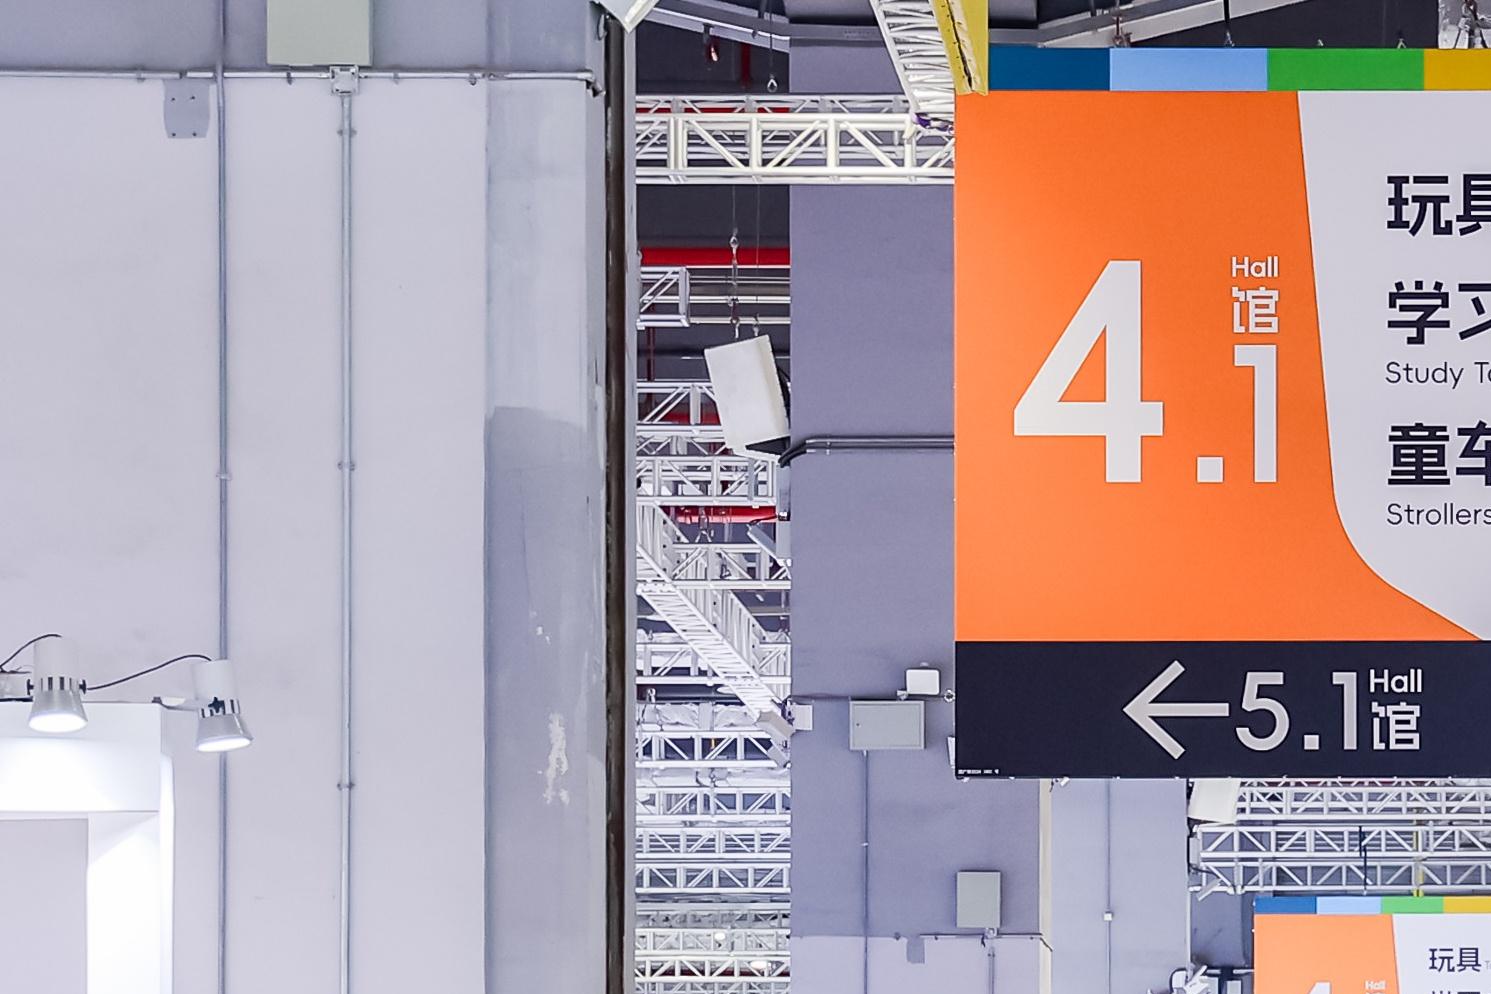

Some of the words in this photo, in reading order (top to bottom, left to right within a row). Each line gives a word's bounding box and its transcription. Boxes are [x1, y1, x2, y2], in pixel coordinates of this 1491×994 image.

[1231, 256, 1279, 278] Hall
[1231, 286, 1279, 334] 馆
[1014, 259, 1279, 484] 4.1
[1386, 361, 1464, 389] Study
[1370, 669, 1421, 692] Hall
[1236, 672, 1358, 750] 5.1
[1372, 702, 1421, 750] 馆
[1429, 947, 1481, 973] 玩具
[1365, 980, 1386, 990] Hall
